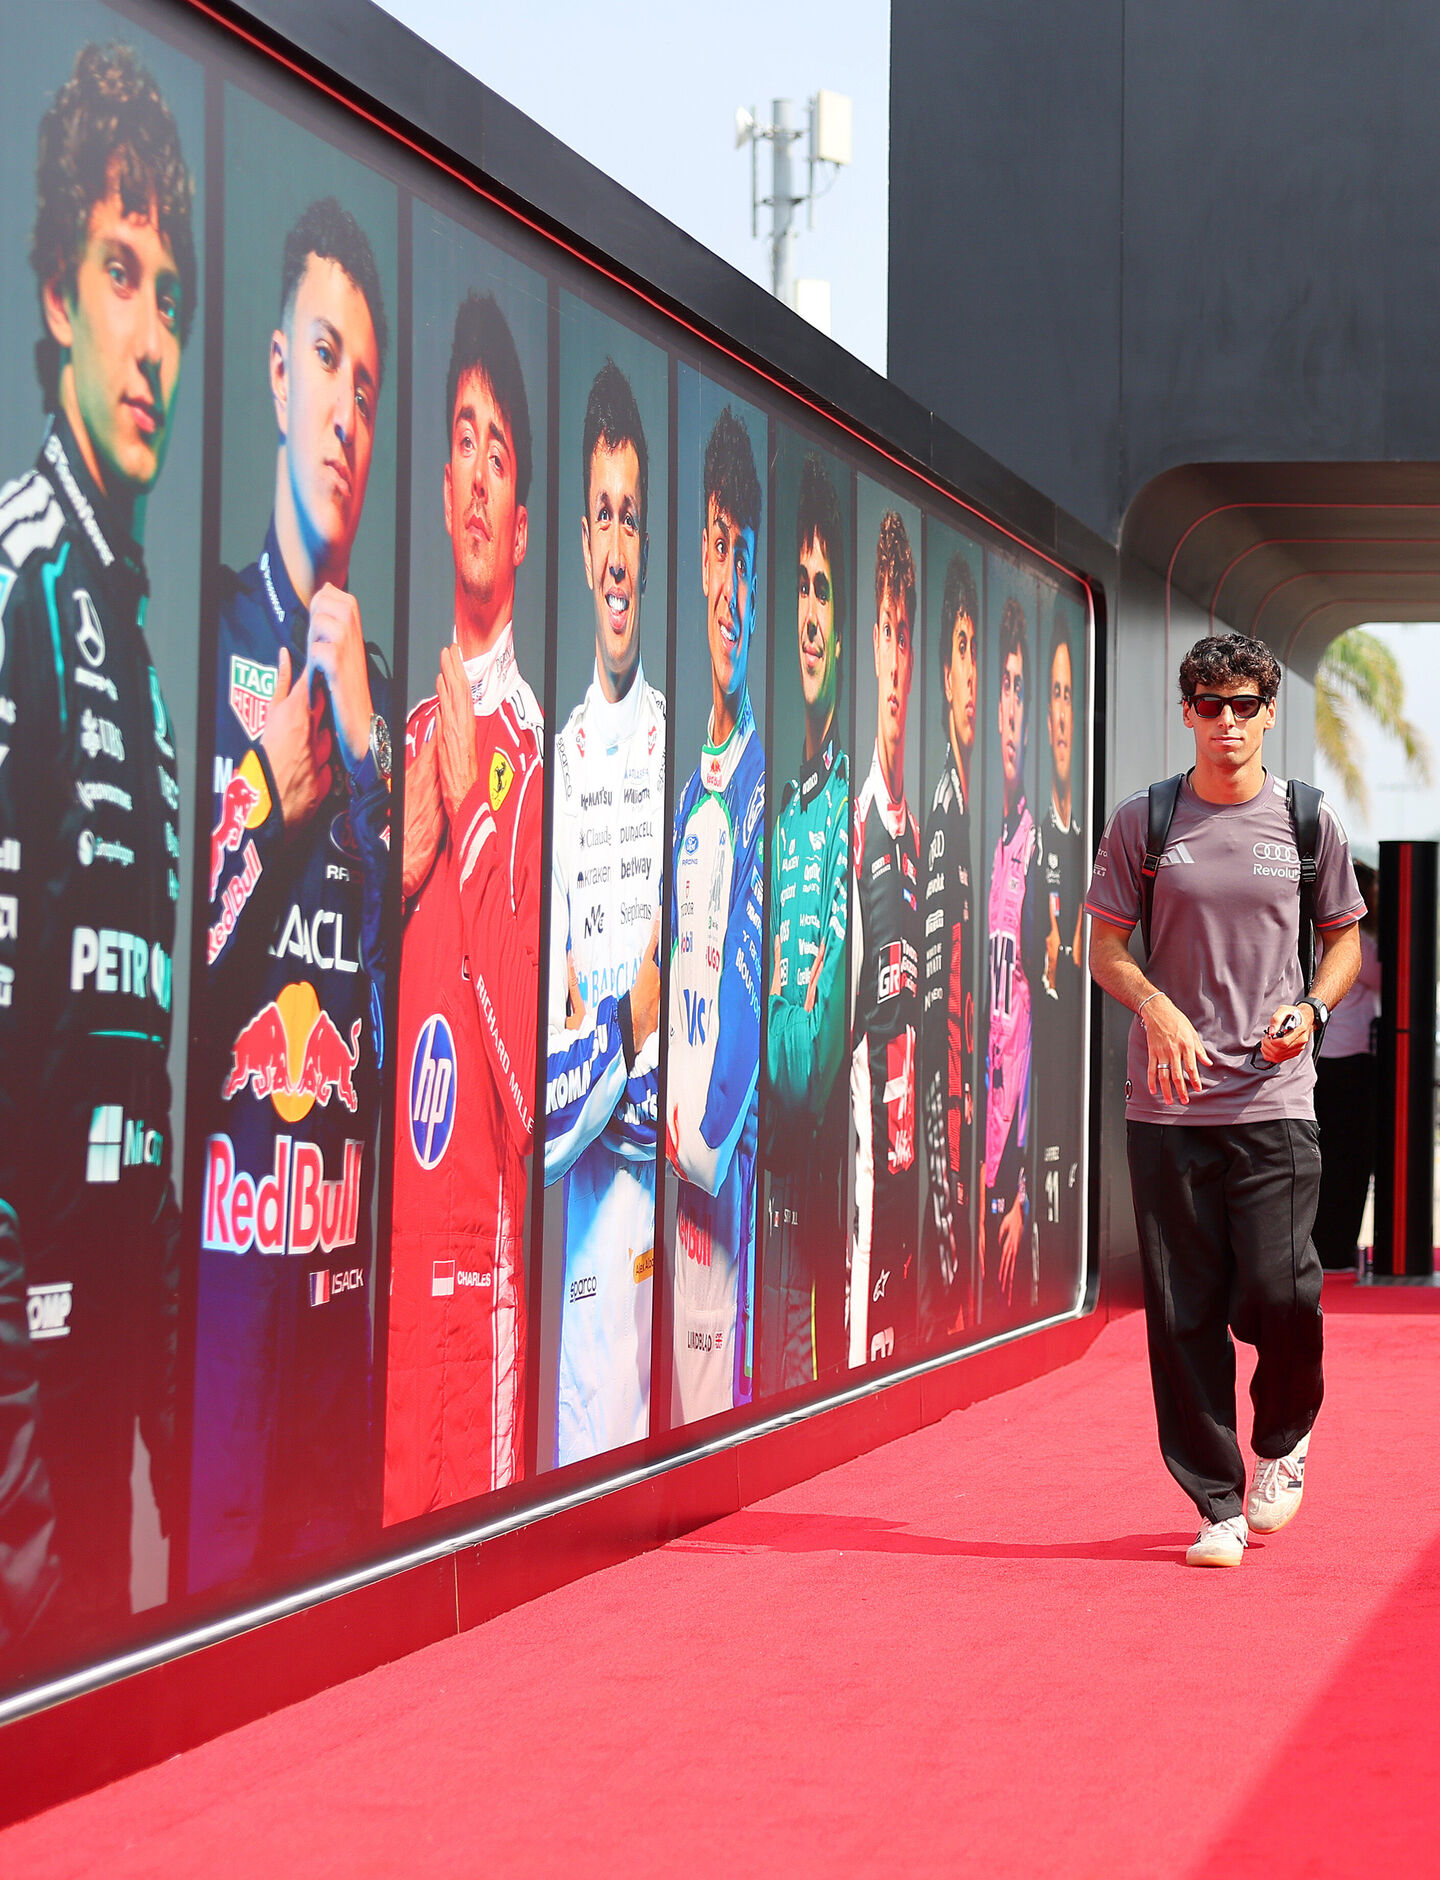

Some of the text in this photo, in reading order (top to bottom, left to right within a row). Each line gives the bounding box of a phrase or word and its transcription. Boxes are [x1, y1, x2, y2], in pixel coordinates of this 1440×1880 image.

[236, 664, 274, 695] TAG
[233, 688, 270, 734] HEUE
[620, 857, 652, 880] betway
[475, 973, 535, 1135] RICHARD MILLE
[413, 1018, 453, 1167] hp
[203, 1133, 365, 1255] Red Bull
[332, 1268, 364, 1295] ISACK
[457, 1270, 491, 1288] CHARLES
[570, 1275, 597, 1302] sparco
